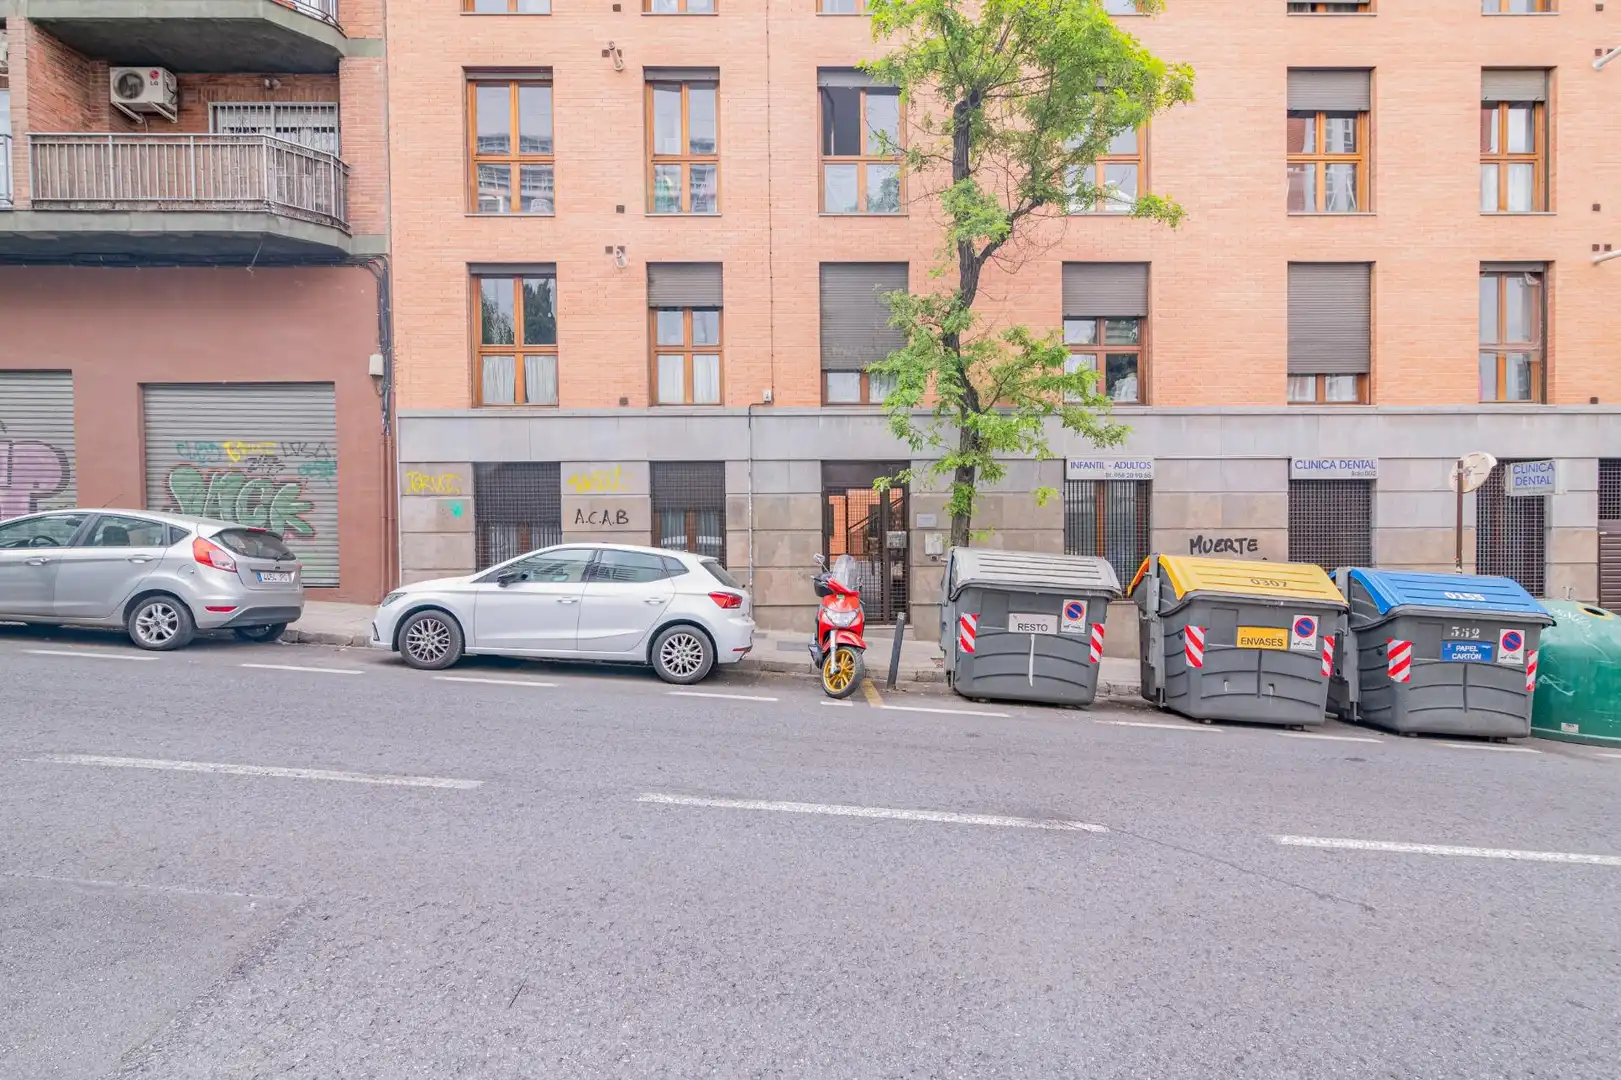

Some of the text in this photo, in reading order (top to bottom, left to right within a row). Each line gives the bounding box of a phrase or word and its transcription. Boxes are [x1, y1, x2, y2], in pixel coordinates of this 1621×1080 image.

[1070, 461, 1105, 469] INFANTIL
[1113, 461, 1152, 470] ADULTOS
[1294, 459, 1376, 470] CLINICA DENTAL
[1512, 462, 1555, 474] CLINICA
[1515, 475, 1552, 486] DENTAL
[575, 508, 629, 526] A.C.A.B
[1189, 534, 1258, 555] MUERTE
[1017, 623, 1048, 632] RESTO
[1240, 636, 1284, 647] ENVASES
[1451, 651, 1482, 660] CARTÓN
